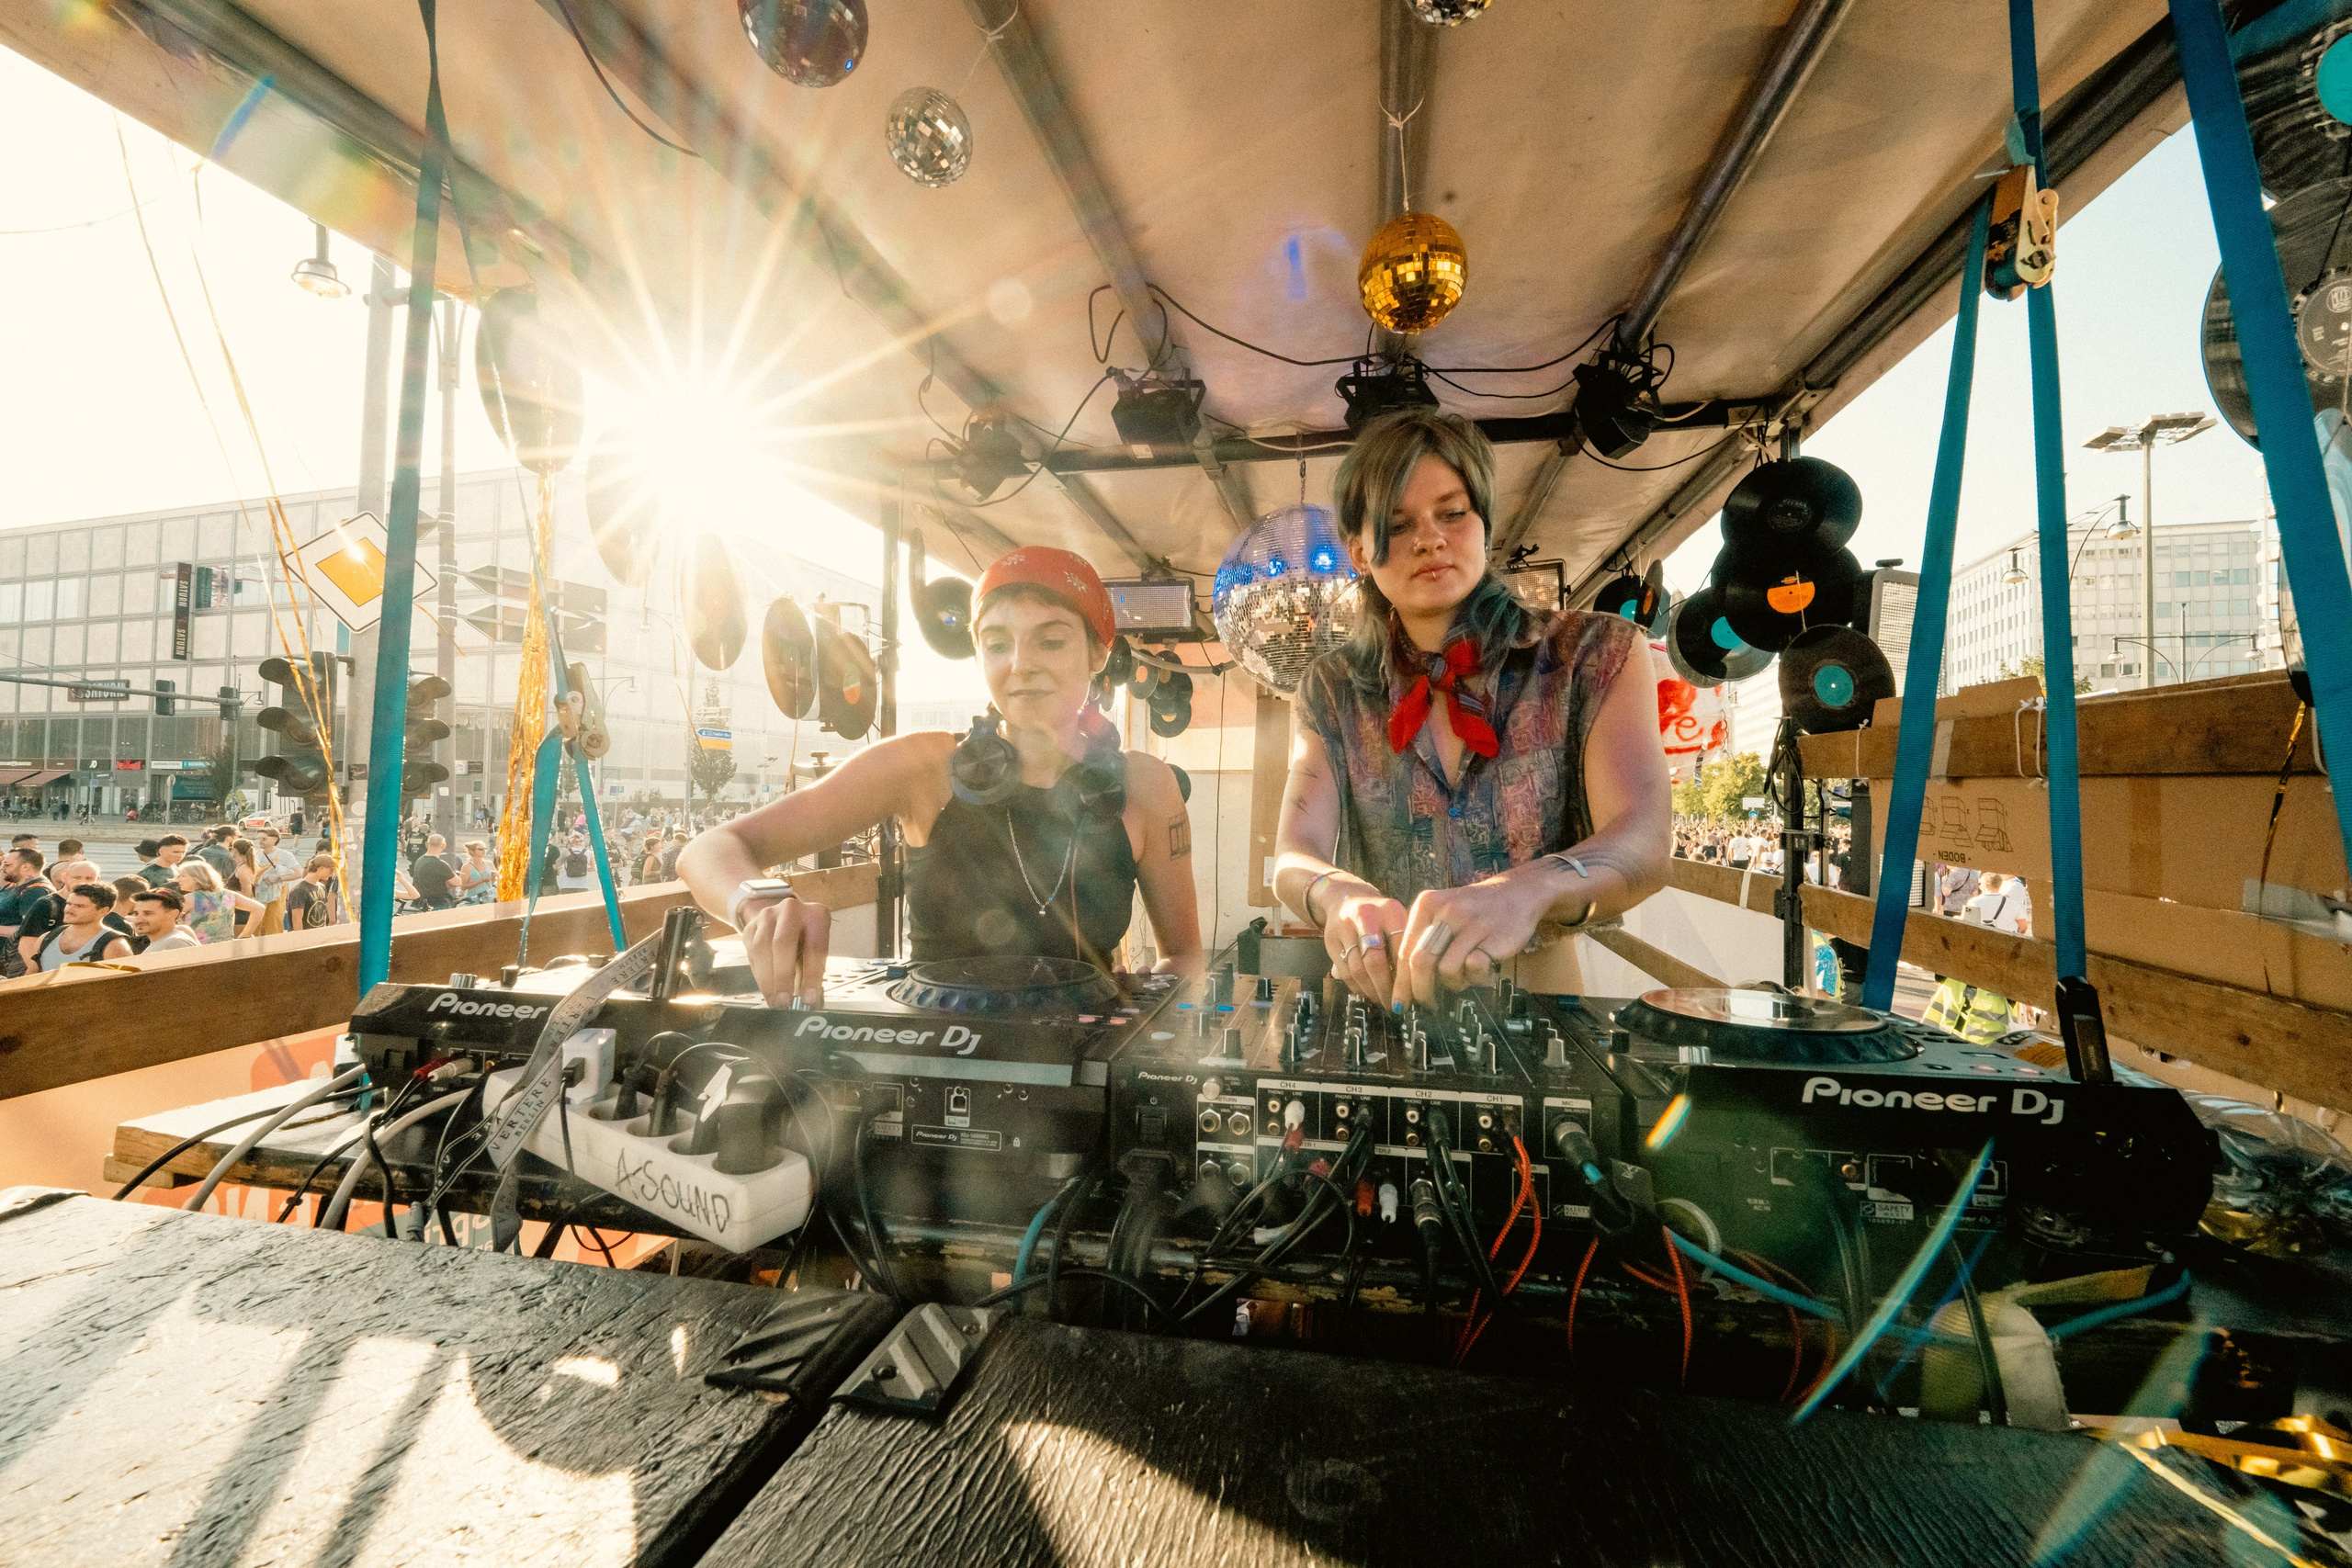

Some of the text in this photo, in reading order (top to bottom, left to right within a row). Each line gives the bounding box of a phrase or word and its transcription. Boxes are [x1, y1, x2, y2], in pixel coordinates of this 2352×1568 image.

[178, 581, 188, 607] SATURN
[175, 628, 187, 656] SATURN
[1938, 850, 1966, 863] BODEN
[610, 951, 656, 985] ERTERE
[427, 992, 548, 1019] Pioneer
[794, 1015, 935, 1045] Pioneer
[1137, 1071, 1183, 1082] Pioneer
[1802, 1077, 1998, 1112] Pioneer
[492, 1077, 551, 1152] VERTERE
[514, 1100, 545, 1138] BERLIN
[916, 1131, 947, 1139] Pioneer
